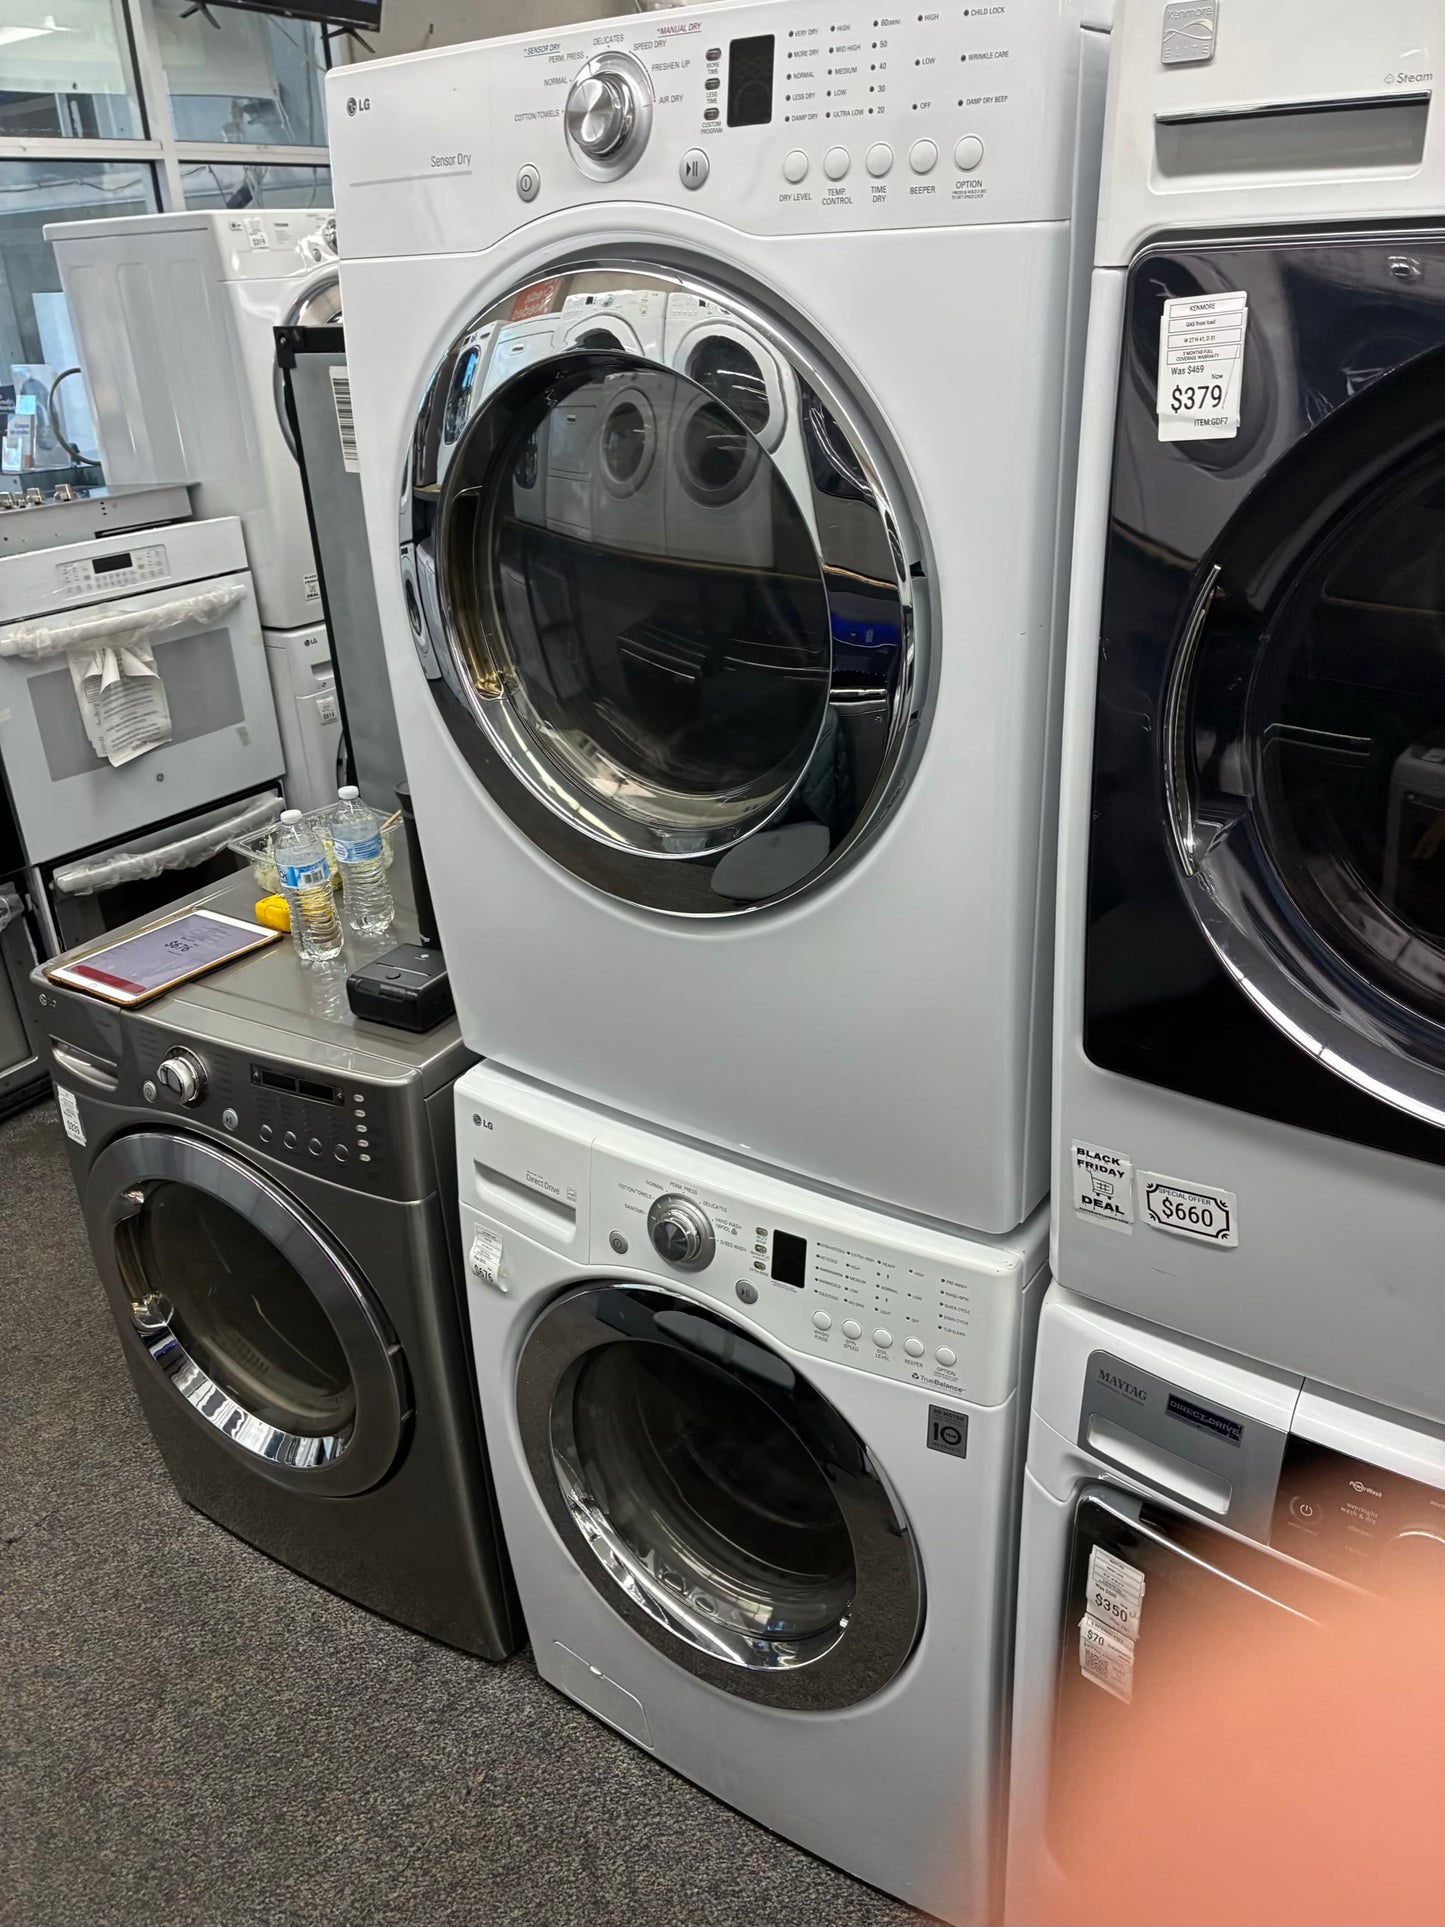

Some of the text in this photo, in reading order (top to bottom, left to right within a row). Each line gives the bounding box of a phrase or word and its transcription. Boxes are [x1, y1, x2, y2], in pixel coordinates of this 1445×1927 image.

[989, 7, 1005, 15] LOCK
[1167, 5, 1213, 20] Kenmore
[683, 23, 702, 33] DRY
[593, 34, 624, 46] DELICATES
[633, 40, 667, 51] SPEED DRY
[544, 43, 560, 52] DRY
[1164, 43, 1210, 59] ELITE
[548, 52, 584, 63] PERM. PRESS
[922, 57, 936, 65] LOW
[968, 52, 993, 61] WRINKLE
[652, 60, 690, 71] FRESHEN UP
[544, 78, 568, 86] NORMAL
[1397, 72, 1433, 84] Steam
[669, 94, 683, 102] DRY
[966, 95, 1008, 105] DAMP DRY BEEP
[359, 98, 370, 111] LG
[514, 110, 559, 121] COTTON/TOWELS
[431, 153, 471, 167] Sensor Dry
[871, 186, 887, 194] TIME
[910, 186, 935, 194] BEEPER
[956, 181, 982, 189] OPTION
[779, 193, 812, 202] DRY LEVEL
[822, 197, 852, 205] CONTROL
[873, 195, 886, 203] DRY
[1190, 303, 1215, 311] KENMORE
[1171, 365, 1204, 375] Was $469
[1171, 385, 1222, 413] $379
[1194, 417, 1228, 427] ITEM:GDF7
[483, 1120, 493, 1130] LG
[1077, 1148, 1120, 1166] BLACK
[1077, 1159, 1125, 1179] FRIDAY
[526, 1173, 544, 1189] Direct
[545, 1183, 560, 1195] Drive
[646, 1180, 664, 1191] NORMAL
[684, 1186, 697, 1195] PRESS
[1158, 1187, 1211, 1205] SPECIAL OFFER
[703, 1200, 727, 1212] DELICATES
[1081, 1195, 1125, 1216] DEAL
[1162, 1197, 1213, 1227] $660
[815, 1335, 828, 1343] RINSE
[844, 1344, 859, 1352] SPEED
[904, 1359, 923, 1368] BEEPER
[937, 1367, 956, 1377] OPTION
[1099, 1369, 1147, 1401] MAYTAG
[1170, 1401, 1240, 1435] DIRECT DRIVE
[1341, 1507, 1357, 1516] wash
[1365, 1516, 1376, 1525] dry
[1347, 1503, 1378, 1518] overnight
[1095, 1593, 1127, 1622] $350
[1087, 1629, 1104, 1646] $70
